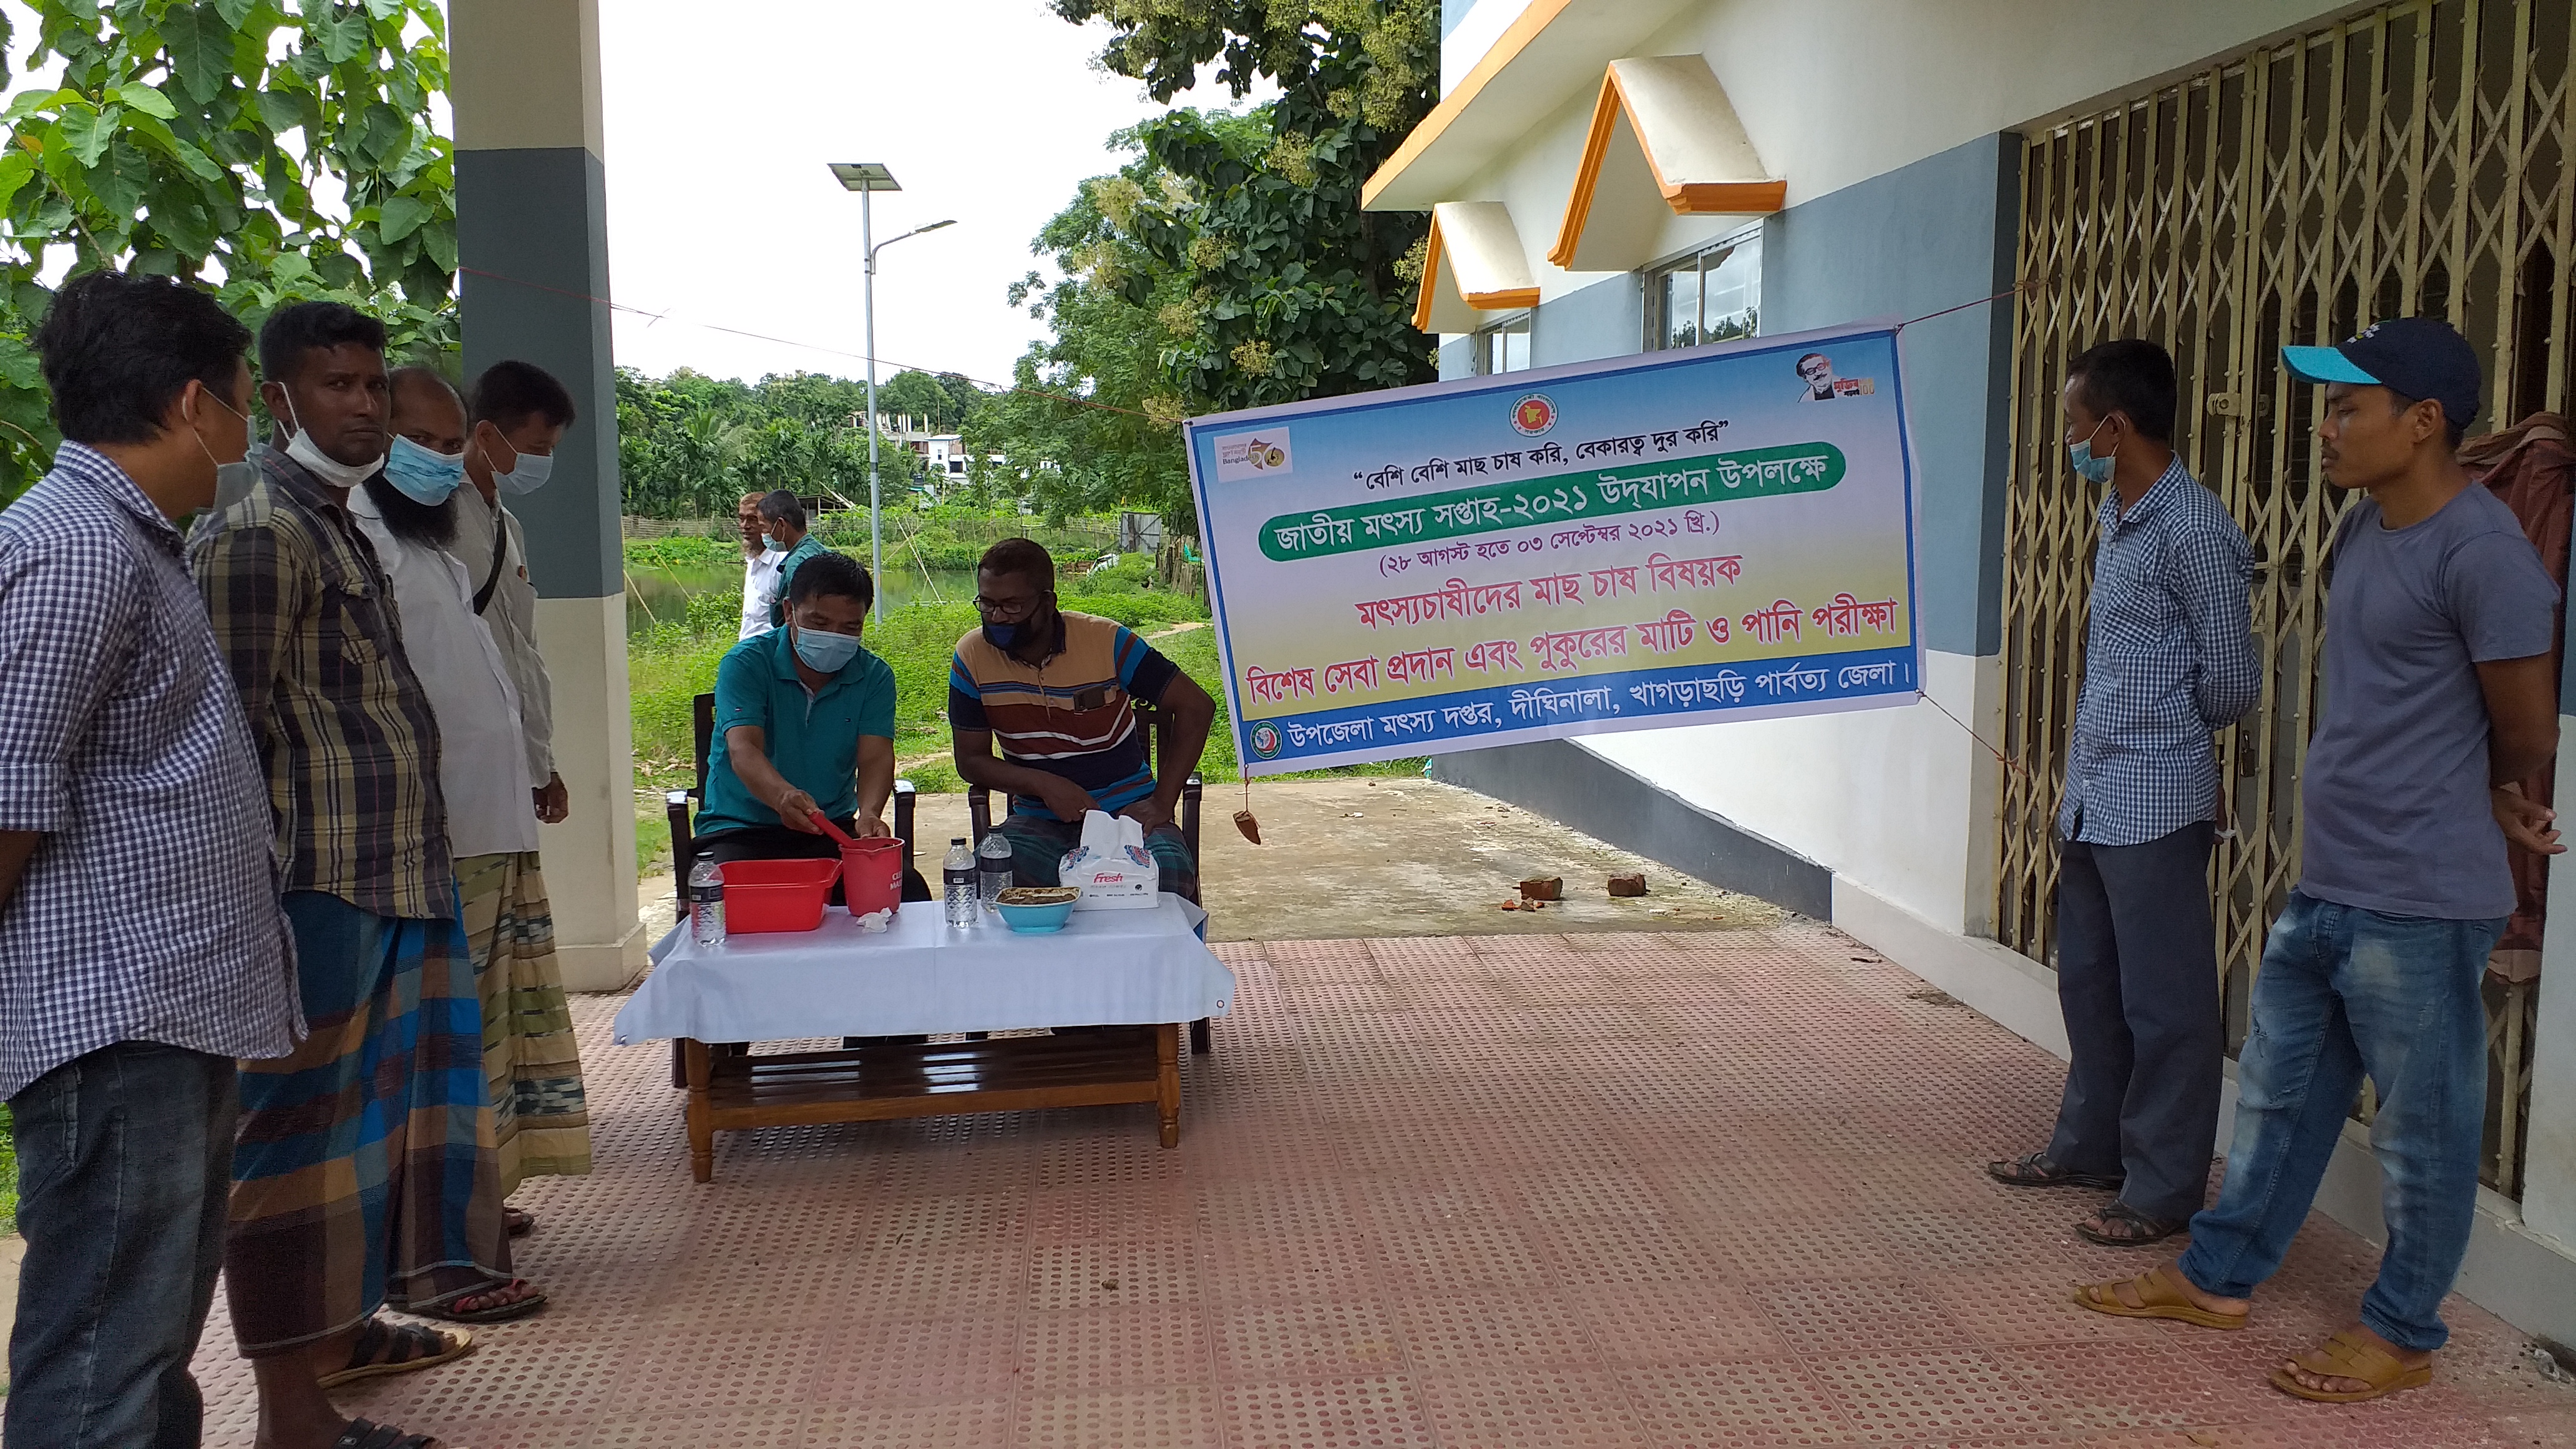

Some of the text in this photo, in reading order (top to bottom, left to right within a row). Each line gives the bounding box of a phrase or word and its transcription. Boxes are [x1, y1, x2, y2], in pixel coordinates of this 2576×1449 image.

[1354, 420, 1729, 490] “বেশি বেশি মাছ চাষ করি, বেকারত্ব দুর করি”
[1274, 514, 1355, 552] জাতীয়
[1360, 508, 1425, 540] মৎস্য
[1435, 486, 1588, 529] সপ্তাহ-২০২১
[1716, 455, 1829, 489] উপলক্ষে
[1378, 510, 1720, 578] (২৮ আগস্ট হতে ০৩ সেপ্টেম্বর ২০২১ খ্রি.)
[1355, 552, 1743, 630] মৎস্যচাষীদের মাছ চাষ বিষয়ক
[1246, 592, 1899, 706] বিশেষ সেবা প্রদান এবং পুকুরের মাটি ও পানি পরীক্ষা
[1287, 715, 1375, 748] উপজেলা
[1378, 709, 1437, 738] মৎস্য
[1441, 700, 1503, 729] দপ্তর,
[1508, 686, 1620, 721] দীঘিনালা,
[1629, 669, 1747, 707] খাগড়াছড়ি
[1754, 662, 1830, 698] পার্বত্য
[1093, 872, 1123, 884] Fresh
